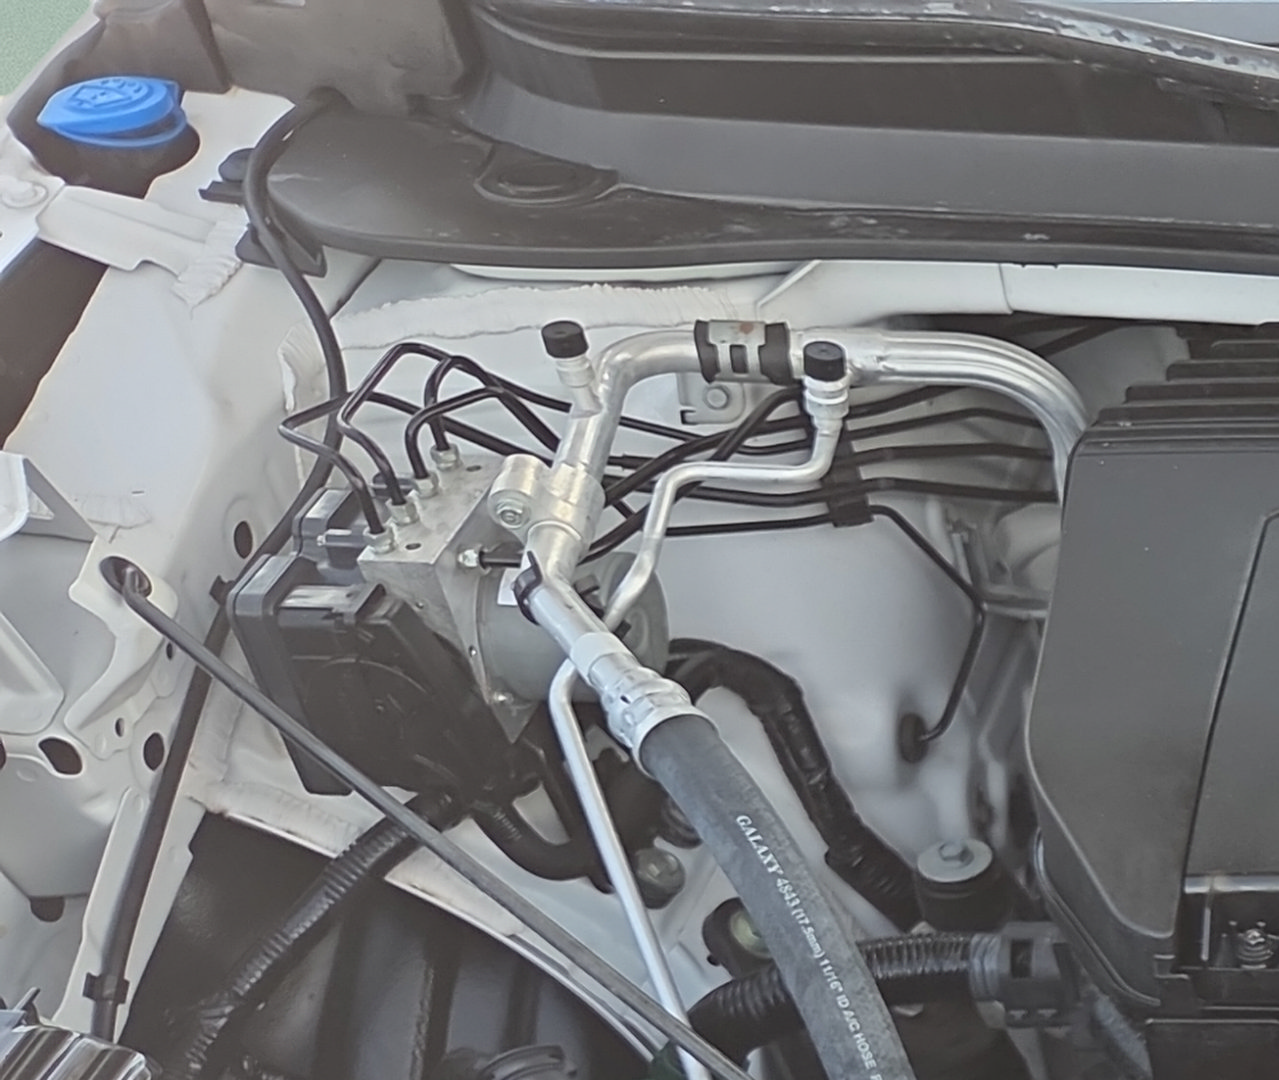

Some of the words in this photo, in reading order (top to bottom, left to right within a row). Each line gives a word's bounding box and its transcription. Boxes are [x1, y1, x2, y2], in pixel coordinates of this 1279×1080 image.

[736, 815, 784, 875] GALAXY
[836, 994, 850, 1008] ID
[842, 1010, 860, 1032] A/C
[853, 1033, 877, 1070] HOSE
